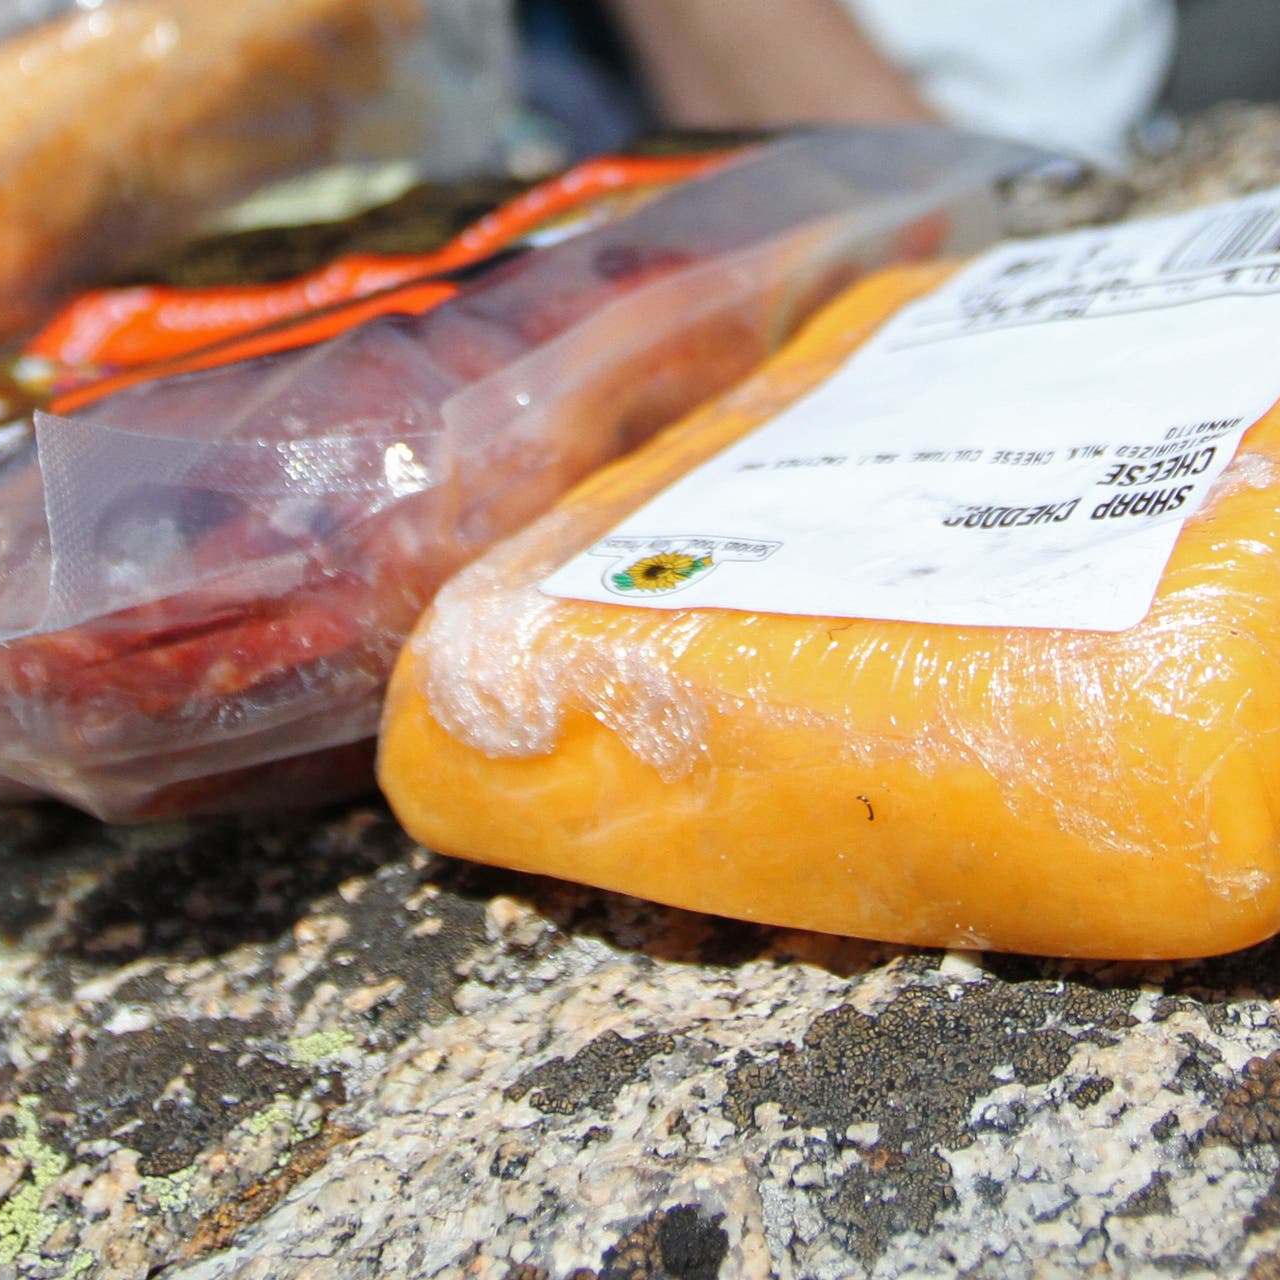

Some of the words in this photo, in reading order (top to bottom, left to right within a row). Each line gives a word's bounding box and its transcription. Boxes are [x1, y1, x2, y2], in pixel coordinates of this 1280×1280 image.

[989, 449, 1056, 467] CHEESE
[1095, 446, 1217, 487] CHEESE
[1088, 484, 1195, 522] SHARP
